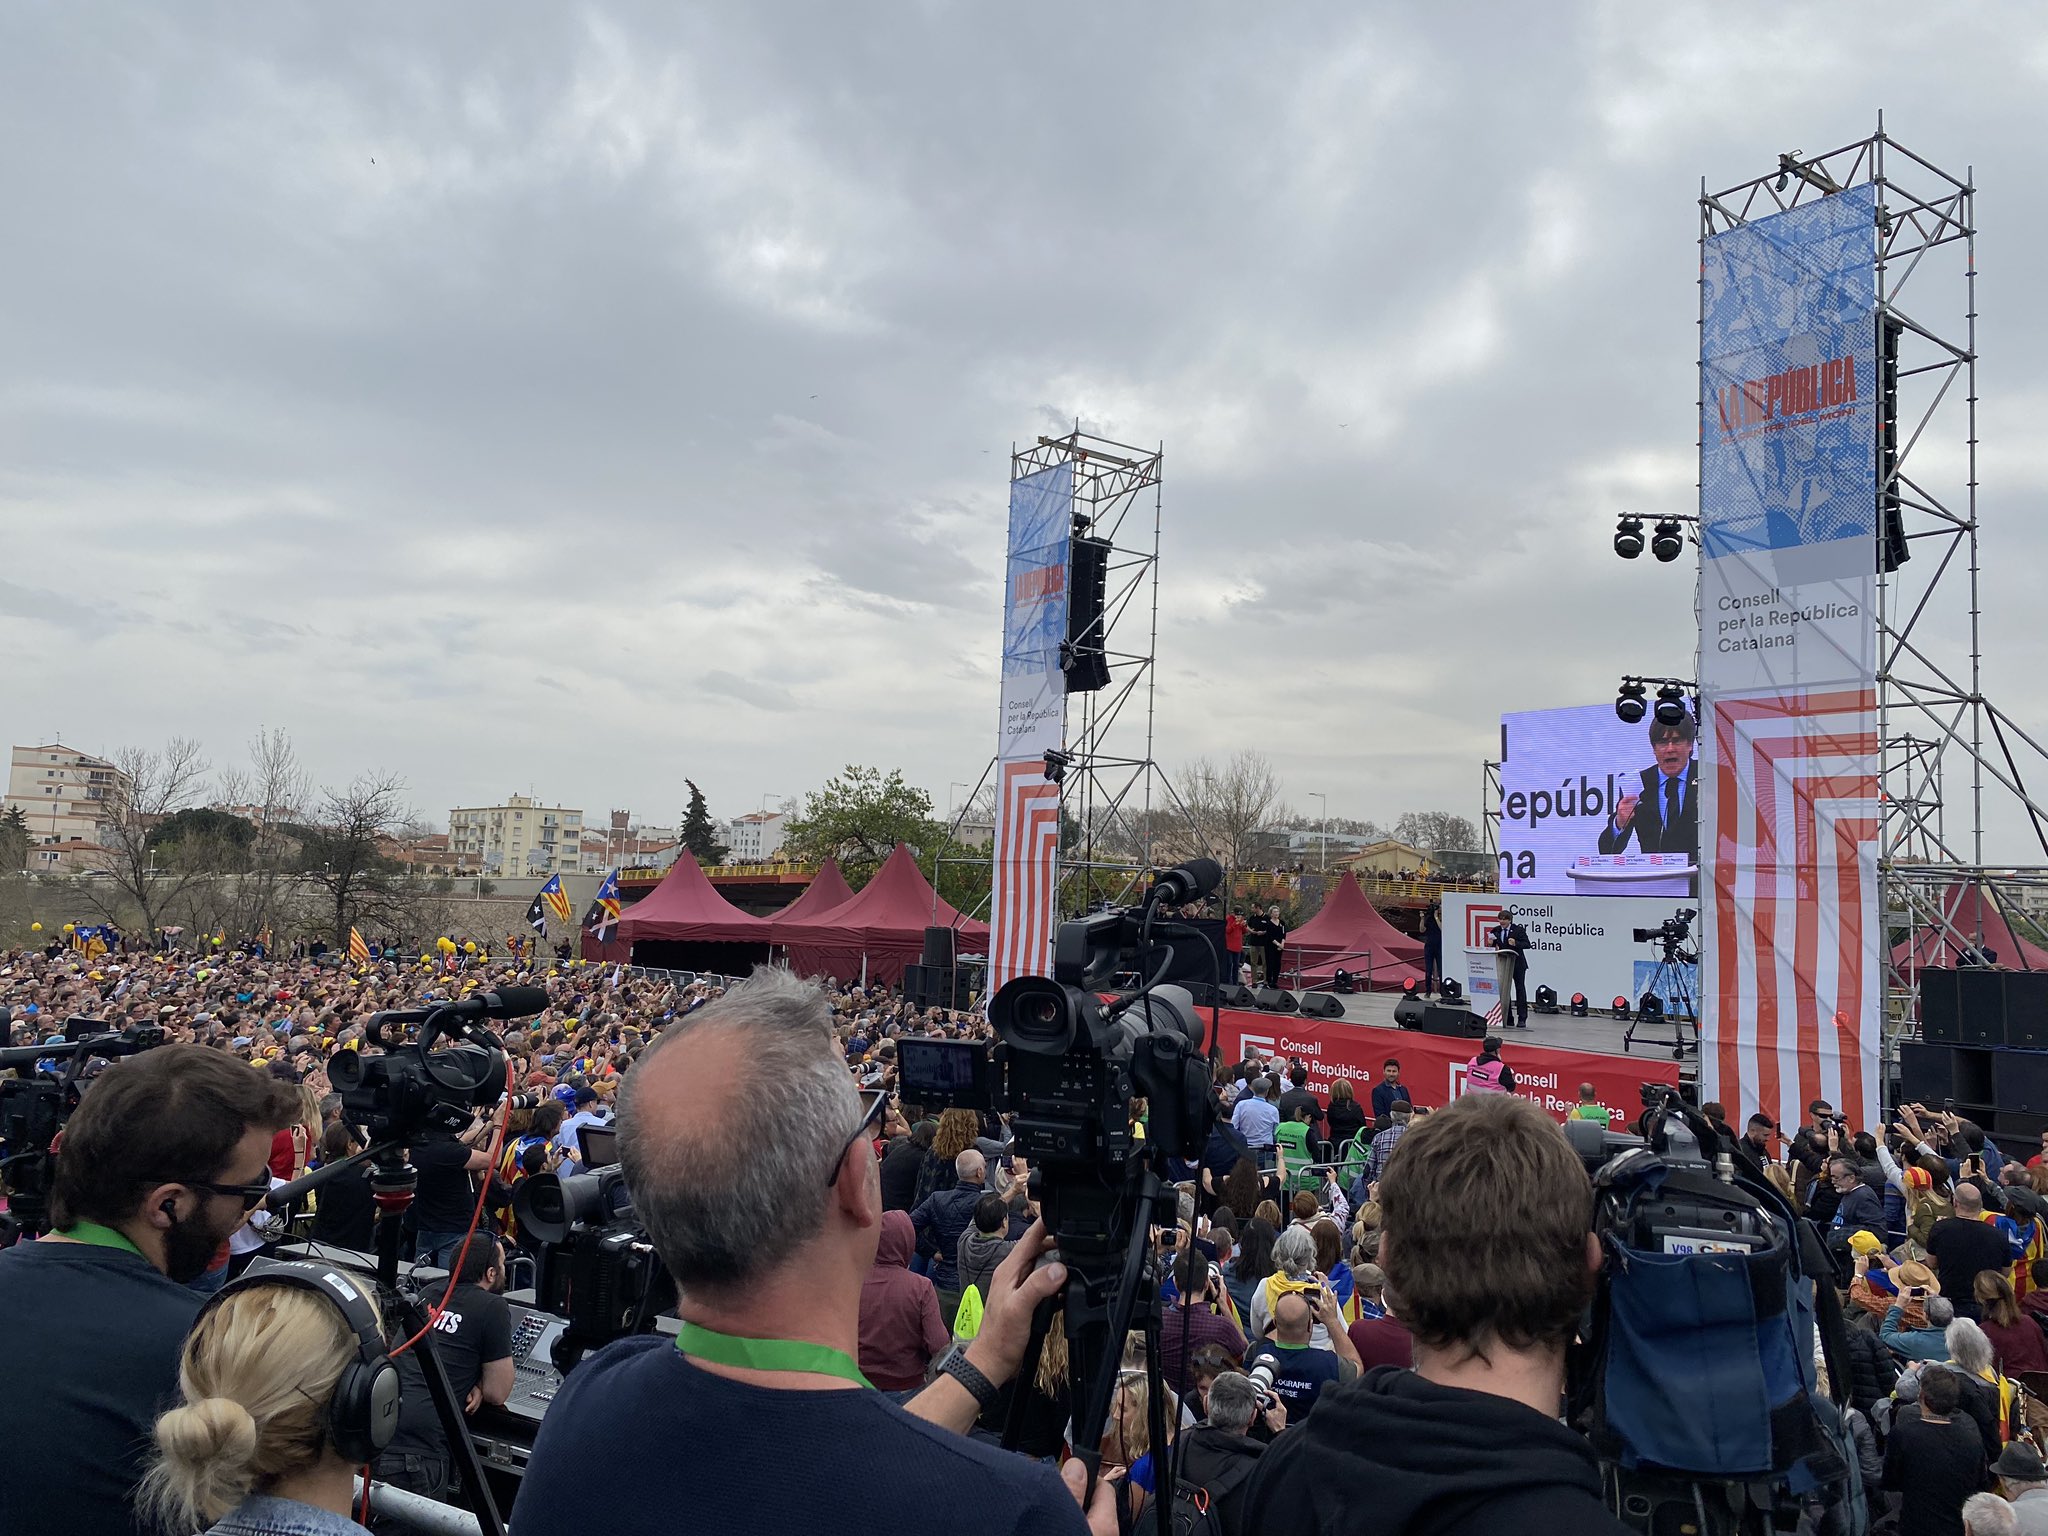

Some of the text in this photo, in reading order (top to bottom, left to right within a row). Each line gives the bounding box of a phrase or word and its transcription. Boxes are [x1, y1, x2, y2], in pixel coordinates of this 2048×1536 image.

[1743, 354, 1857, 426] REPÚBLICA
[1718, 588, 1780, 611] Consell
[1718, 603, 1859, 635] per la República
[1717, 634, 1795, 653] Catalana
[1008, 698, 1033, 710] Consell
[1008, 714, 1019, 724] per
[1027, 708, 1059, 721] República
[1509, 904, 1553, 918] Consell
[1531, 921, 1541, 933] la
[1544, 922, 1605, 938] República
[1280, 1037, 1322, 1056] Consell
[1311, 1059, 1370, 1082] República
[444, 1116, 460, 1127] JVC
[1671, 1243, 1693, 1255] V98
[1277, 1378, 1313, 1390] OGRAPHE
